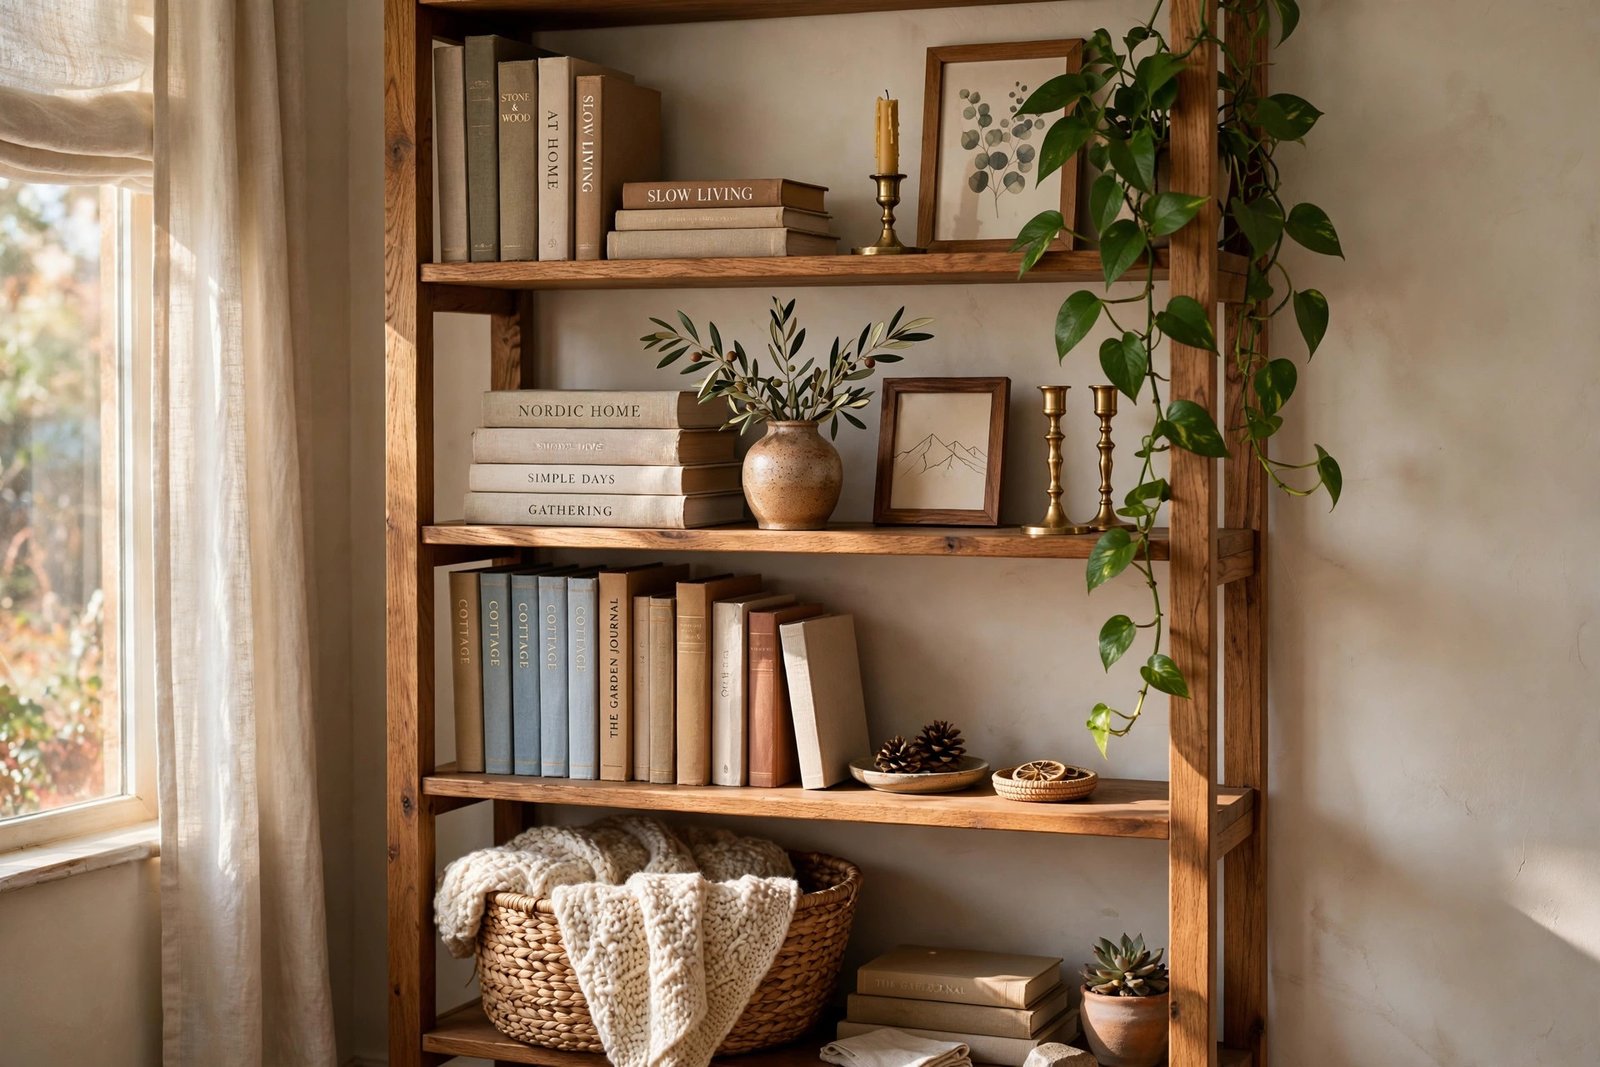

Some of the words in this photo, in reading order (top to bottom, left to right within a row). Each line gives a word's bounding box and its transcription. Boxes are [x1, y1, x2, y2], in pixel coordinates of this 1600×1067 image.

[501, 93, 531, 102] STONE
[501, 113, 531, 123] WOOD
[511, 103, 519, 111] &
[582, 95, 594, 136] SLOW
[547, 110, 559, 130] AT
[547, 138, 559, 191] HOME
[582, 142, 594, 193] LIVING
[647, 188, 692, 203] SLOW
[697, 186, 753, 202] LIVING
[518, 404, 584, 418] NORDIC
[591, 404, 641, 418] HOME
[527, 473, 576, 484] SIMPLE
[581, 474, 616, 485] DAYS
[528, 504, 613, 517] GATHERING
[458, 598, 470, 665] COTTAGE
[488, 600, 501, 667] COTTAGE
[518, 602, 529, 669] COTTAGE
[546, 604, 557, 671] COTTAGE
[575, 606, 586, 672] COTTAGE
[610, 598, 620, 654] JOURNAL
[610, 657, 619, 708] GARDEN
[610, 714, 618, 738] THE
